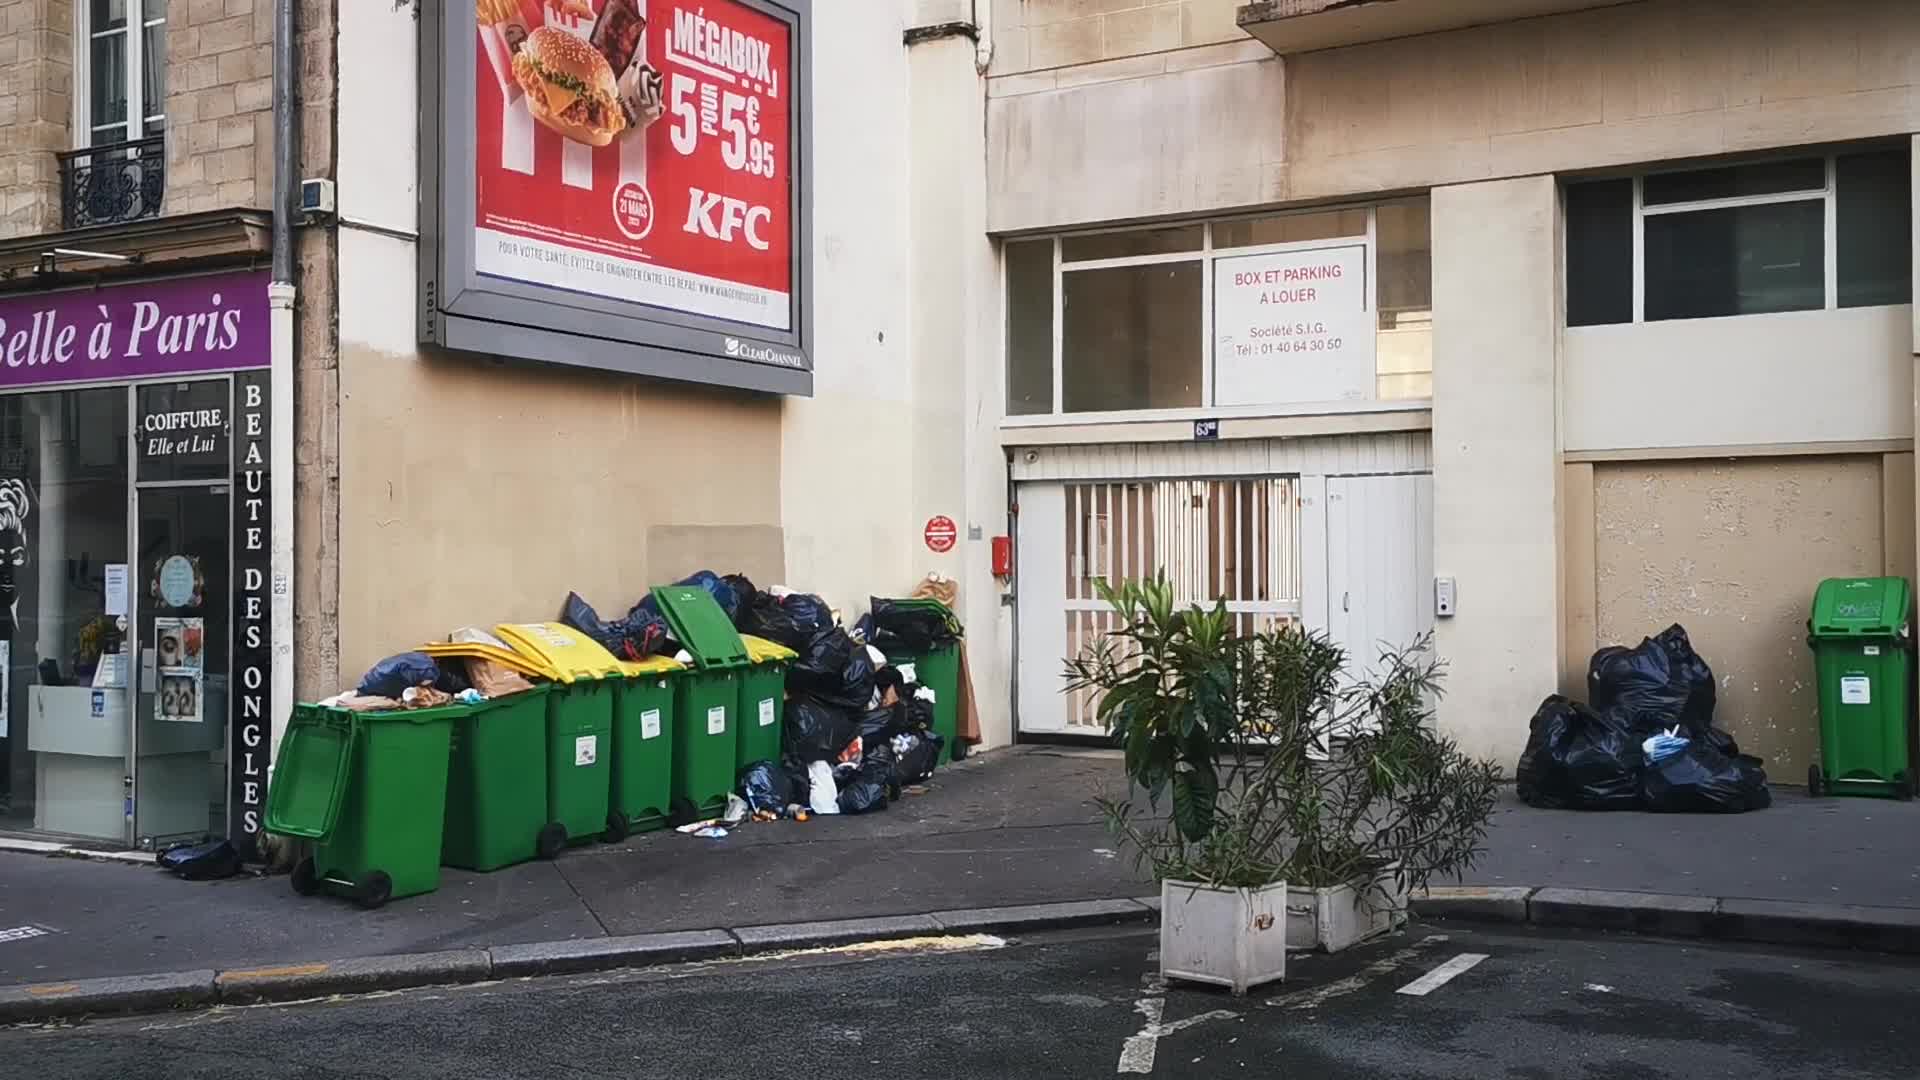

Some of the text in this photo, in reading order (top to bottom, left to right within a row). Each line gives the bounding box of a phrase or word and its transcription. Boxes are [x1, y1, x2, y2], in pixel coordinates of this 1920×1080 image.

[674, 7, 771, 84] MÉGABOX
[670, 72, 697, 155] 5
[700, 82, 719, 136] POUR
[682, 187, 771, 251] KFC
[498, 239, 518, 256] POUR
[519, 244, 544, 263] VOTRE
[642, 269, 663, 286] ENTRE
[664, 275, 676, 289] LES
[1234, 264, 1342, 286] BOX ET PARKING
[1260, 288, 1316, 304] A LOUER
[0, 293, 241, 368] elle à Paris
[1250, 322, 1327, 338] Société S.I.G.
[1261, 343, 1273, 354] 01
[1276, 342, 1291, 353] 40
[1293, 341, 1307, 352] 64
[1310, 339, 1324, 351] 30
[1327, 337, 1342, 350] 50
[145, 408, 222, 431] COIFFURE
[147, 434, 216, 456] Elle et Lui
[242, 384, 263, 834] BEAUTE DES ONGLES
